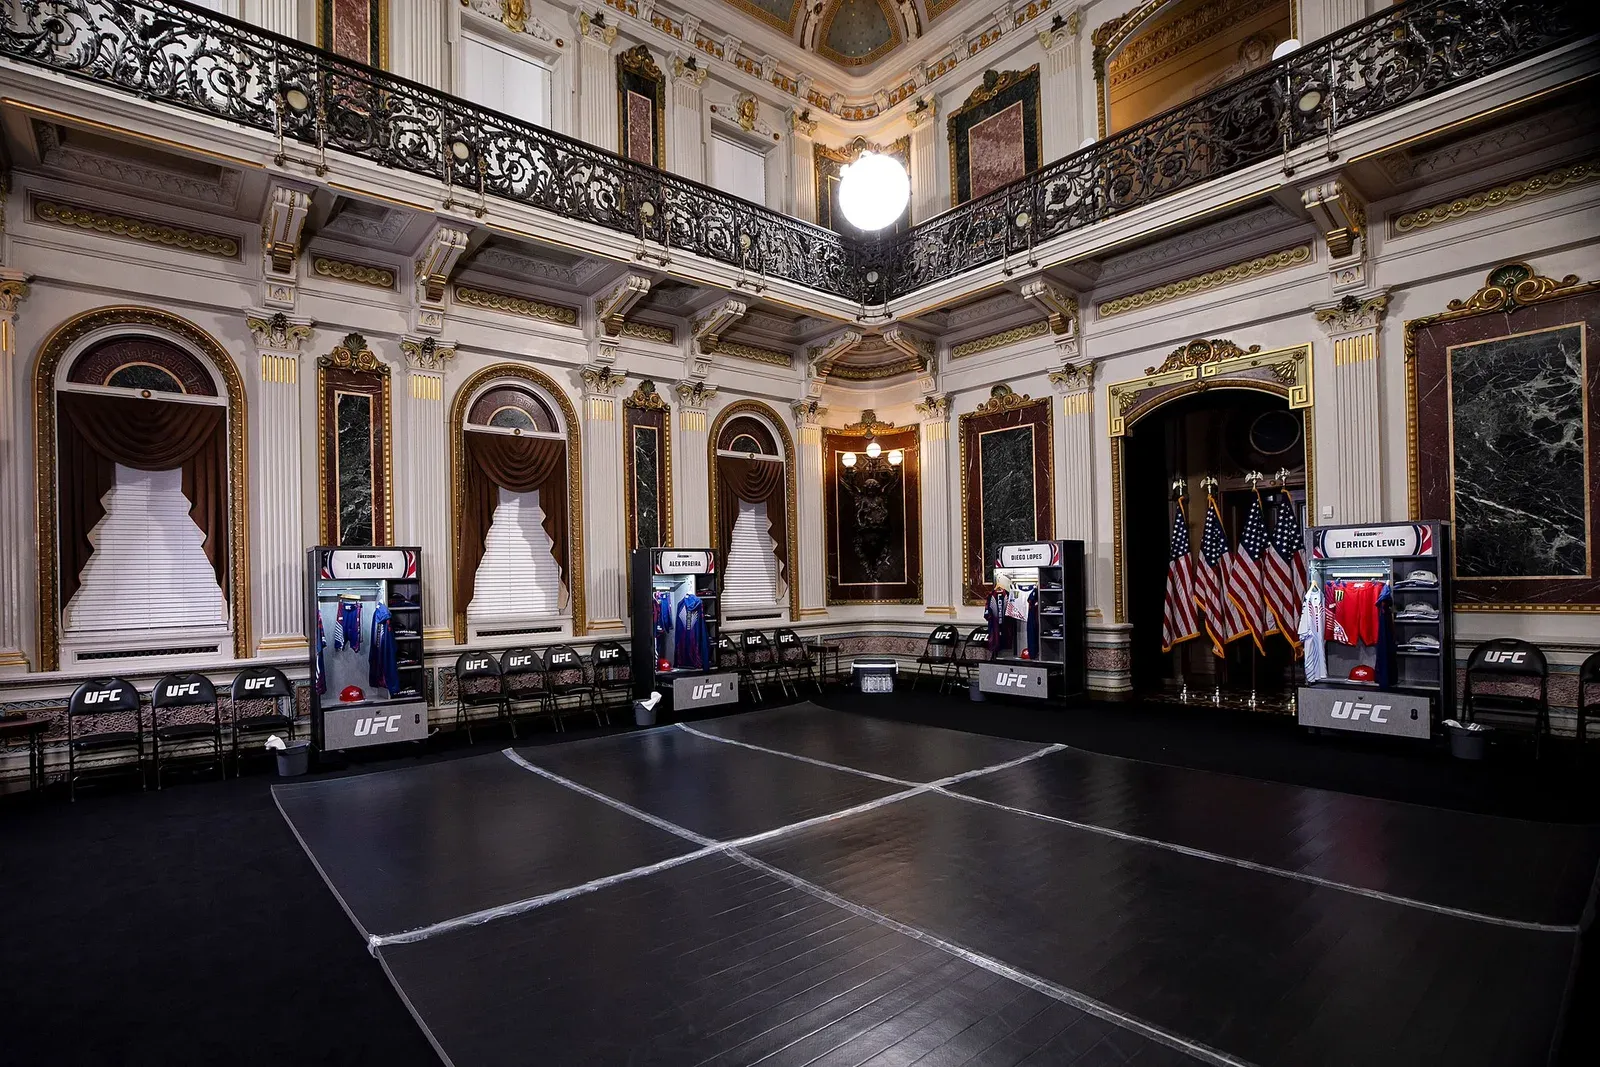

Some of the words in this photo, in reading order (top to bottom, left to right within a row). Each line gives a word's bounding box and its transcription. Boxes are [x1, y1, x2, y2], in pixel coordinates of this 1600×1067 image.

[1335, 540, 1374, 549] DERRICK
[1376, 538, 1406, 548] LEWIS
[346, 562, 361, 570] ILIA
[362, 562, 394, 570] TOPURIA
[746, 635, 762, 645] UFC
[779, 634, 794, 643] UFC
[934, 631, 952, 640] UFC
[718, 639, 728, 648] FC
[552, 652, 572, 664] UFC
[599, 648, 619, 659] UFC
[1484, 650, 1527, 664] UFC
[465, 658, 489, 671] UFC
[509, 655, 532, 667] UFC
[244, 676, 276, 690] UFC
[995, 672, 1028, 688] UFC
[84, 688, 123, 704] UFC
[165, 682, 201, 698] UFC
[691, 682, 722, 700] UFC
[1330, 700, 1392, 724] UFC
[353, 714, 402, 737] UFC
